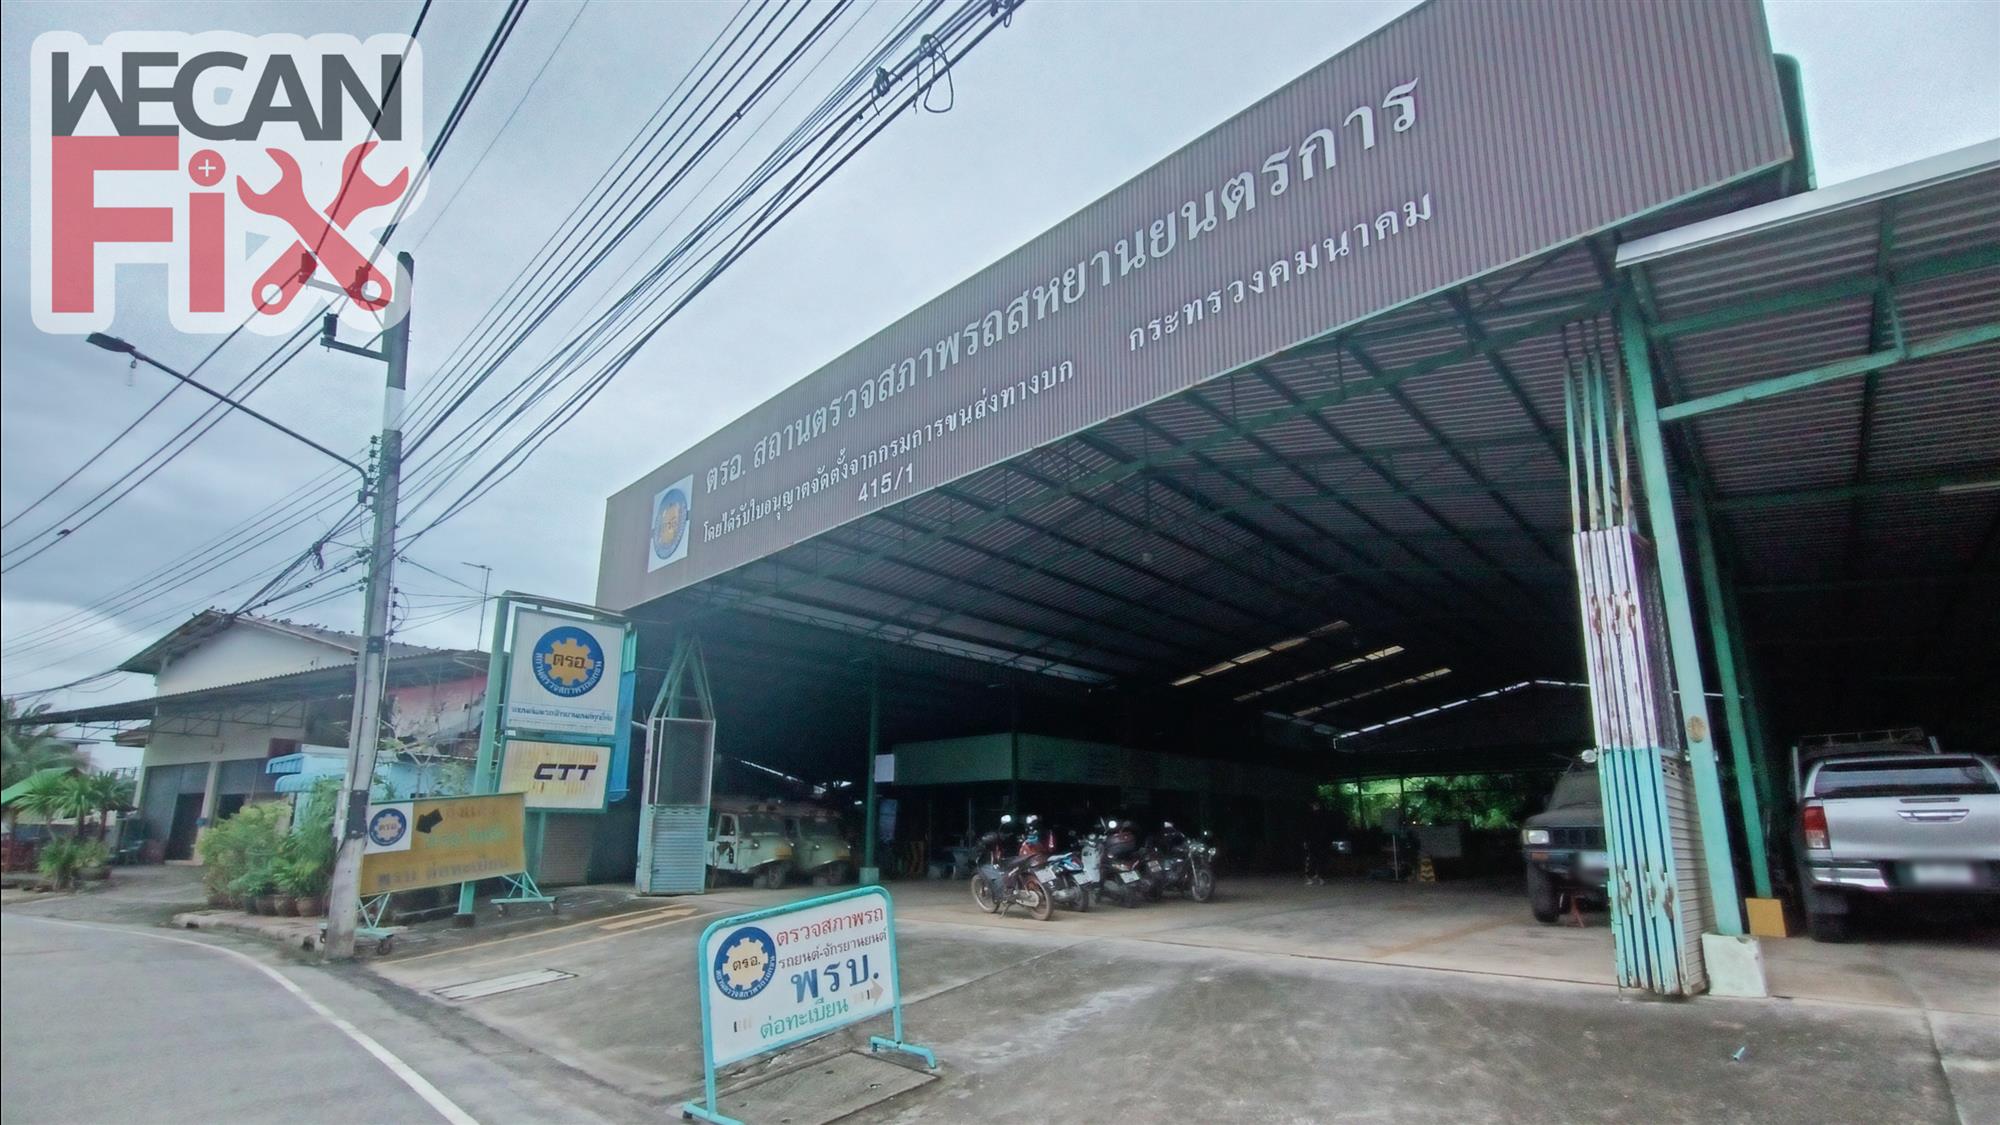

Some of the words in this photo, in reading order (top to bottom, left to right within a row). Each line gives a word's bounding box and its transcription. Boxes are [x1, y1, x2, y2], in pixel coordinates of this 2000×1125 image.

[703, 359, 1074, 543] โดยได้รับใบอนุญาตจัดตั้งจากกรมการขนส่งทางบก
[1128, 193, 1432, 352] กระทรวงคมนาคม
[706, 453, 746, 494] ตรอ.
[858, 461, 915, 502] 415/1
[533, 763, 597, 781] CTT
[776, 907, 884, 947] ตรวจสภาพรถ
[732, 955, 761, 972] ตรอ.
[790, 954, 879, 1004] พรบ.
[759, 997, 849, 1039] ต่อทะเบียน
